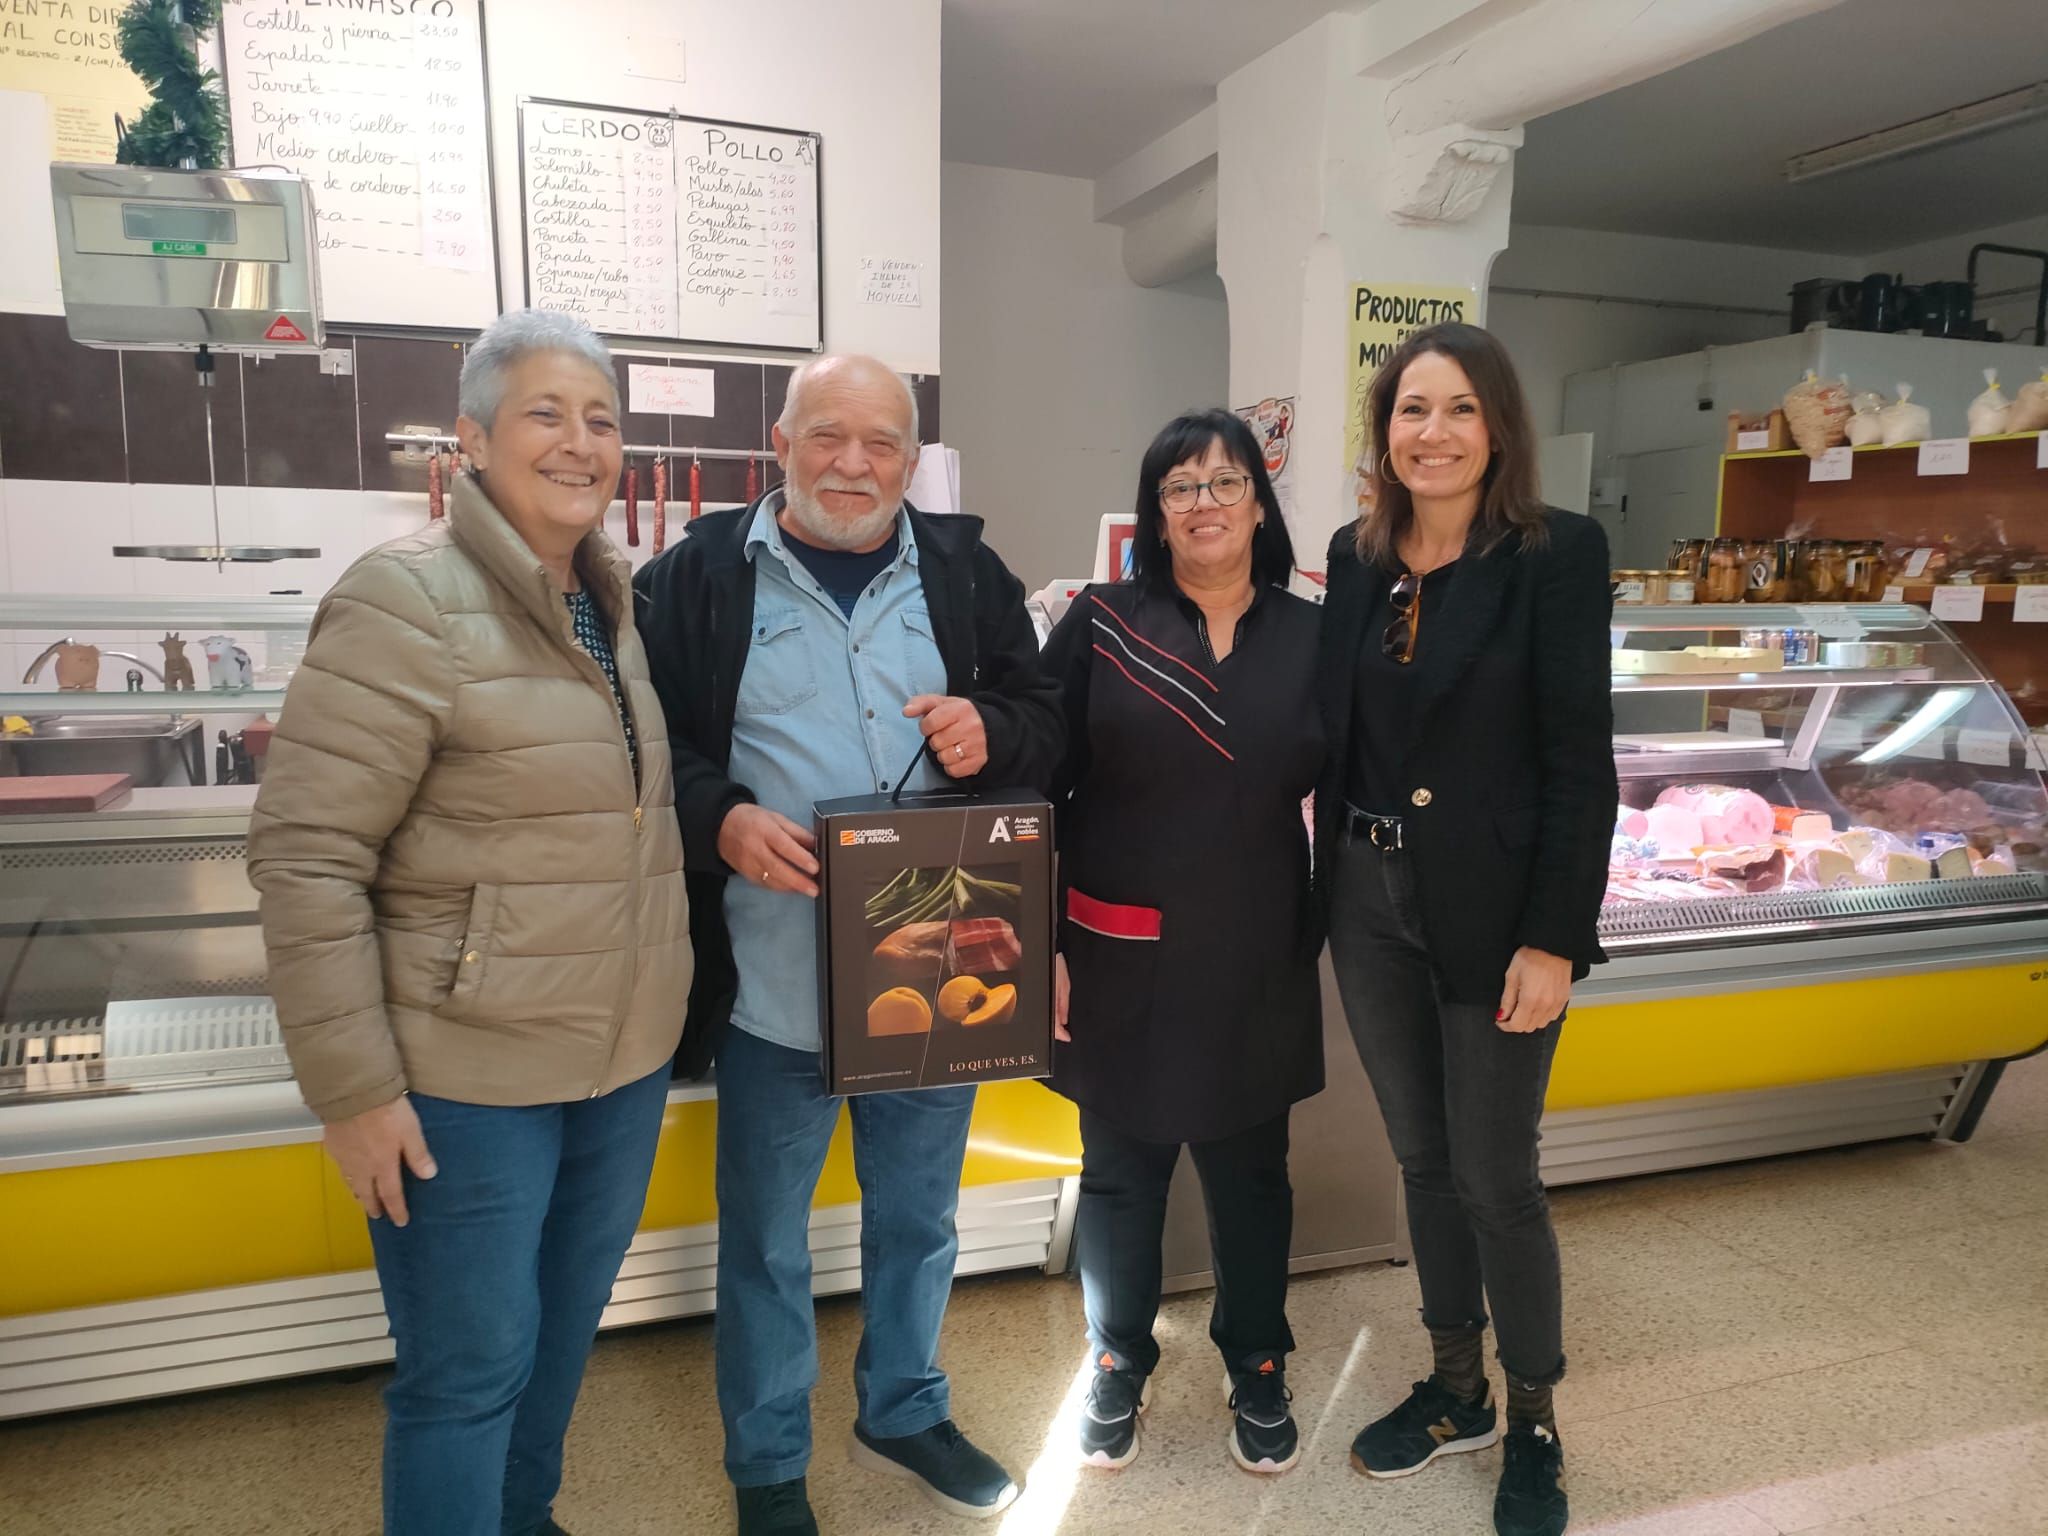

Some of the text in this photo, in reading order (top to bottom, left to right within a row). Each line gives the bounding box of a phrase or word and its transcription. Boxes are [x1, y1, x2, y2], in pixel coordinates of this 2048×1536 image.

[88, 5, 121, 25] DIR
[3, 21, 35, 41] AL
[243, 8, 316, 34] Costilla
[321, 24, 334, 50] y
[341, 22, 397, 51] pierna
[243, 40, 330, 72] Espalda
[247, 70, 322, 95] Jarrete
[251, 101, 303, 135] Bajo
[543, 113, 640, 141] CERDO
[256, 132, 319, 160] Medio
[328, 141, 400, 165] cordero
[529, 137, 583, 157] Lomo
[703, 129, 784, 163] POLLO
[533, 157, 603, 177] Solomillo
[685, 155, 730, 176] Pollo
[324, 170, 341, 190] de
[350, 173, 410, 196] cordero
[532, 175, 591, 194] Chuleta
[532, 191, 614, 212] Cabezada
[687, 191, 751, 220] Pechugas
[534, 209, 594, 229] Costilla
[533, 227, 588, 245] Panceta
[688, 229, 751, 247] Gallina
[535, 242, 597, 266] Papada
[686, 243, 731, 262] Pavo
[688, 261, 747, 280] Codorniz
[859, 257, 918, 271] SE VENDEN
[686, 278, 740, 308] Conejo
[866, 289, 919, 304] MOYUELA
[538, 297, 592, 314] Careta
[1355, 286, 1464, 325] PRODUCTOS
[855, 828, 895, 838] GOBIERNO
[855, 837, 866, 845] DE
[949, 1054, 1038, 1073] LO QUE VES, ES.
